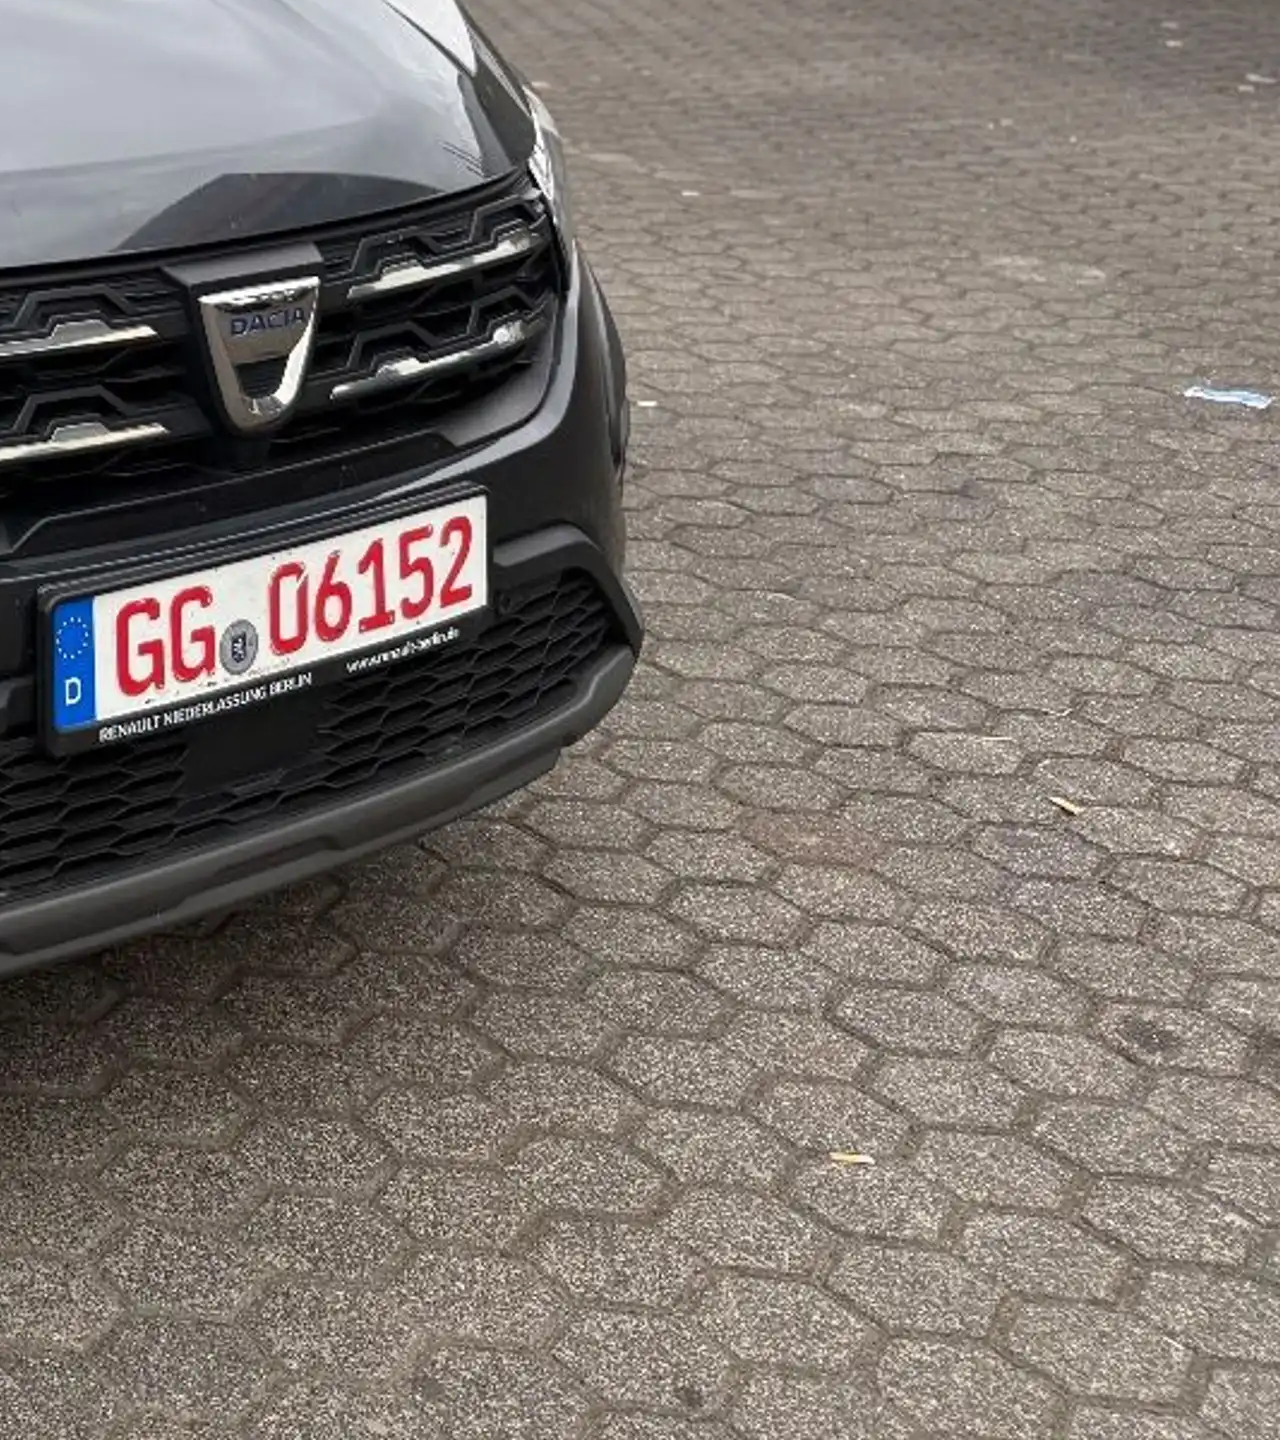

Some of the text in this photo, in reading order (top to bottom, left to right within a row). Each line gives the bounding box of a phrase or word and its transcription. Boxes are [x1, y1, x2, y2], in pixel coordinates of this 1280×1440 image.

[229, 306, 308, 337] DACIA
[115, 514, 474, 698] GG 06152
[64, 676, 82, 707] D
[99, 671, 314, 742] RENAULT NIEDERLASSUNG BERLIN
